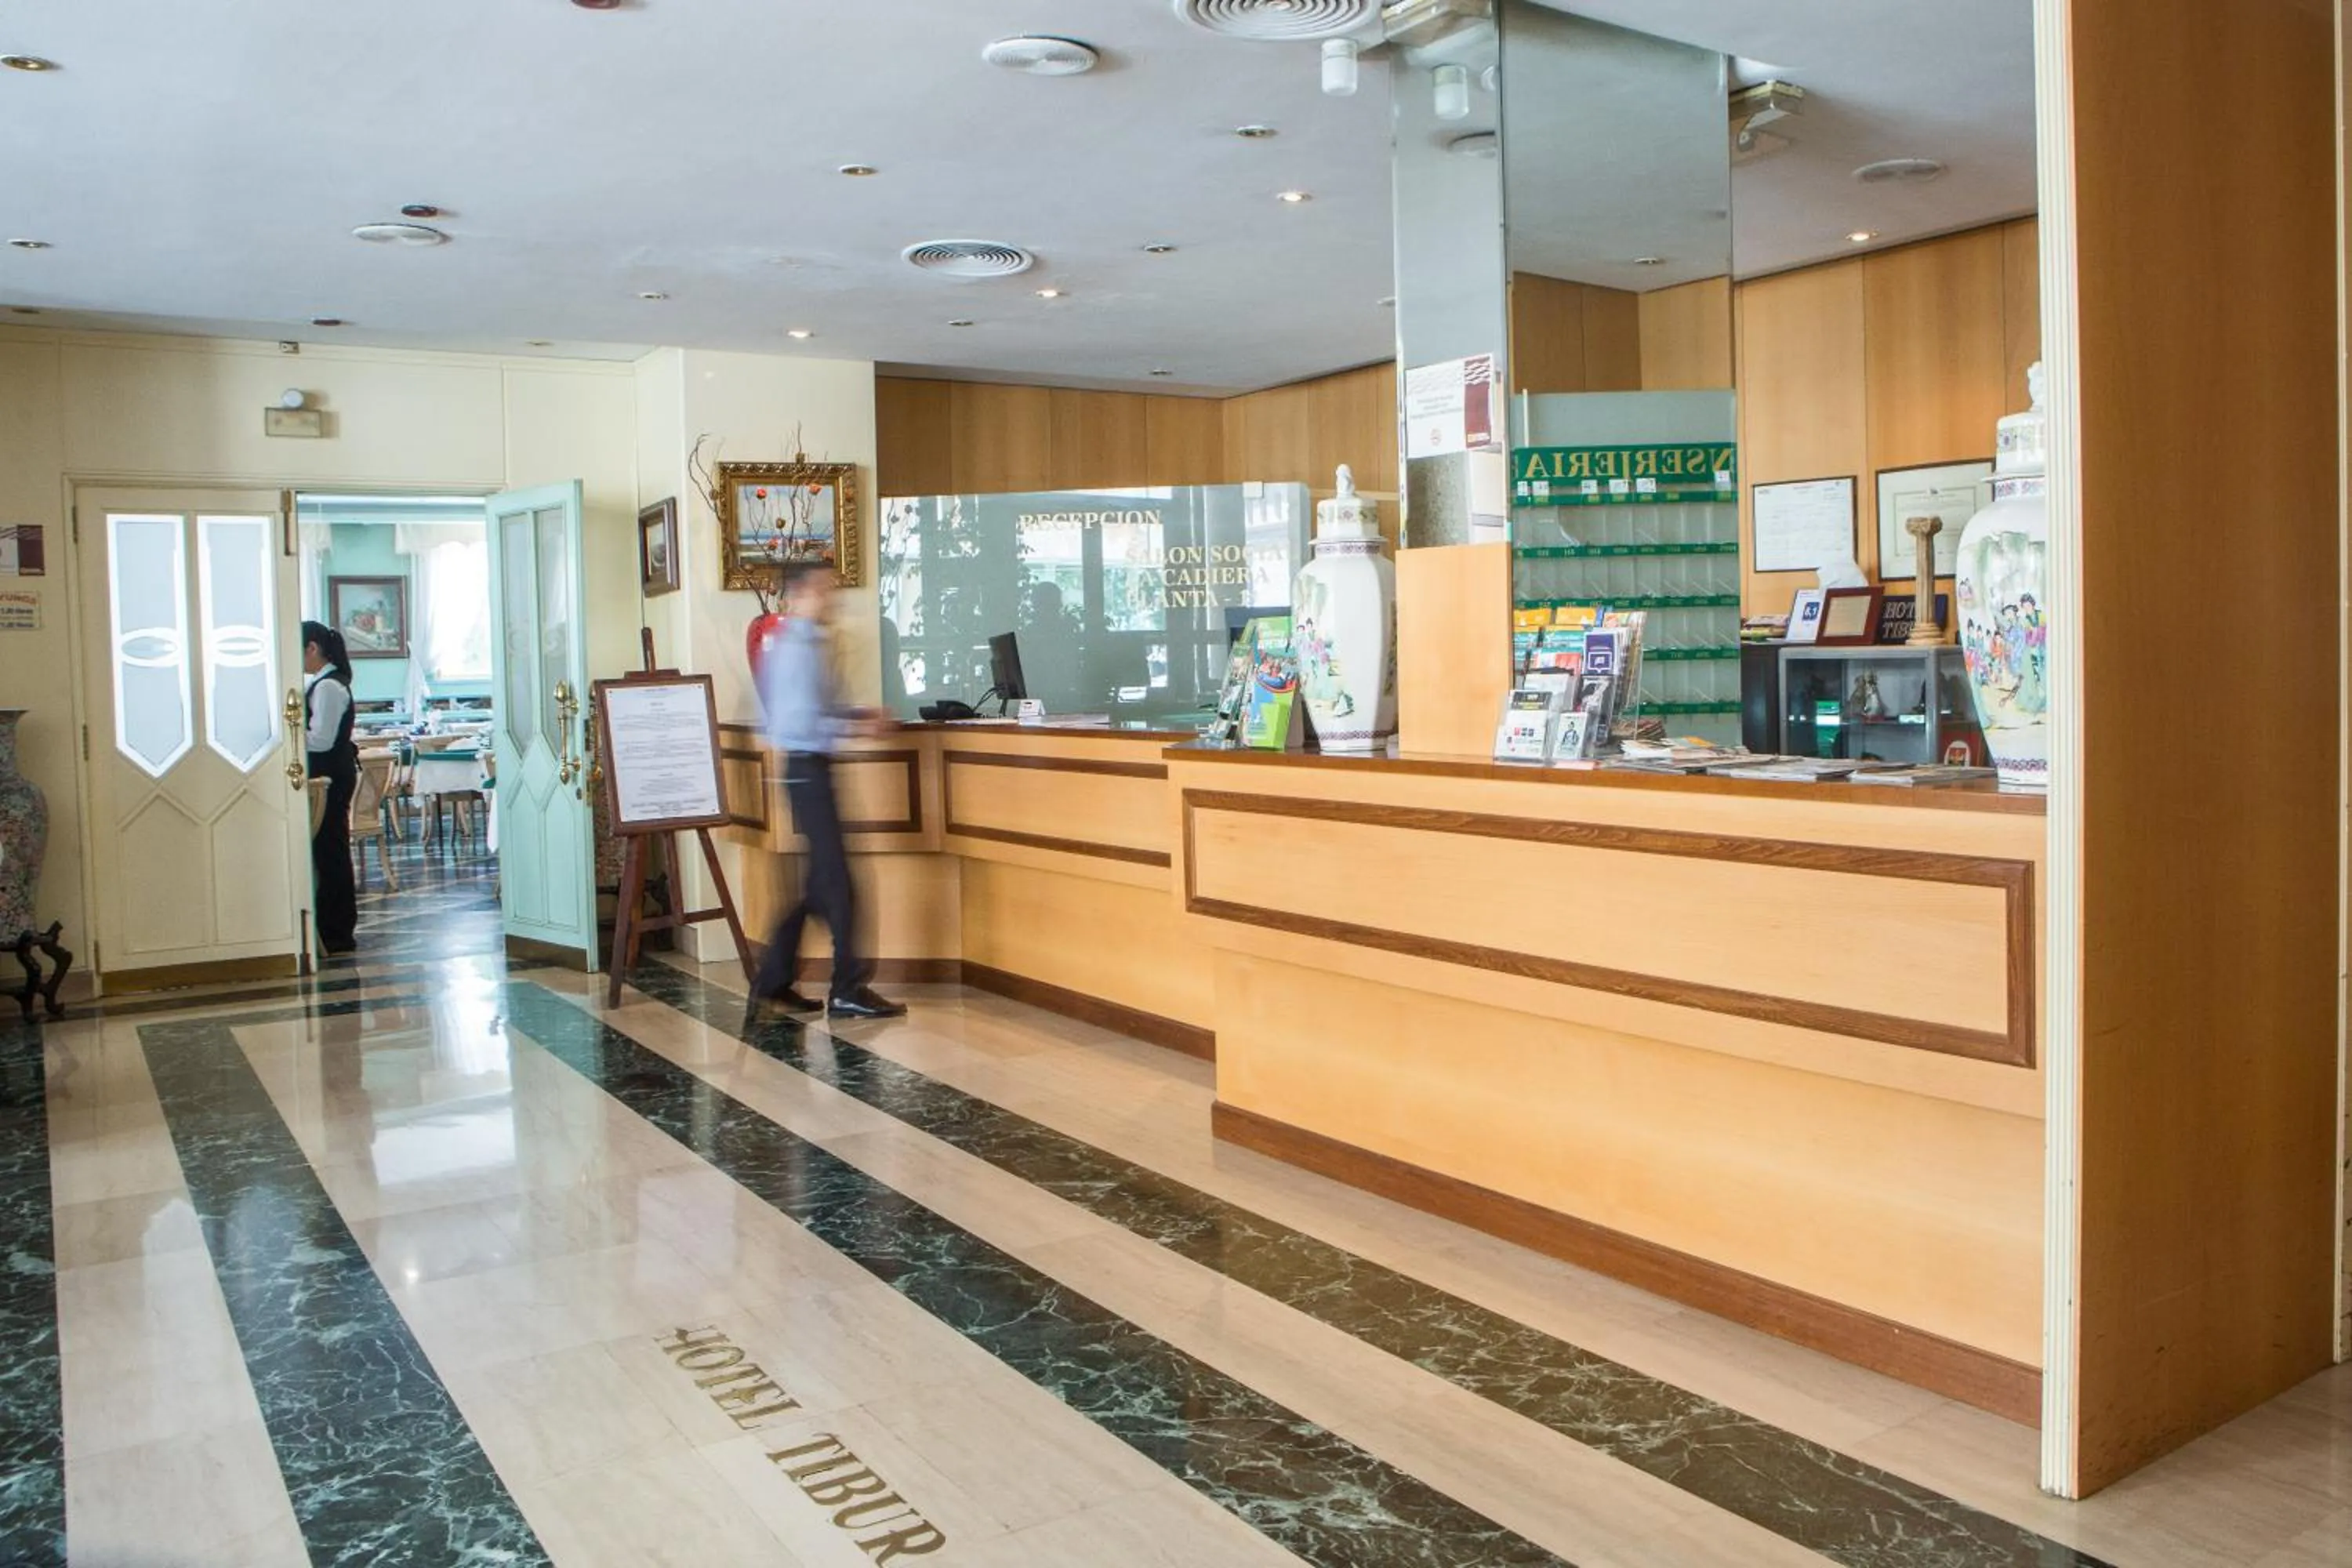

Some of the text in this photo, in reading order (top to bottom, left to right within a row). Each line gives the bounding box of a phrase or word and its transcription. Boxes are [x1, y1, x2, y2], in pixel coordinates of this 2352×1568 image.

[1018, 510, 1161, 531] RECEPCION
[1210, 545, 1287, 563] SOCIA
[1163, 567, 1270, 586] CADIERA
[1127, 589, 1218, 609] PLANTA
[1882, 601, 1915, 618] HOT
[1882, 621, 1913, 638] TIB
[652, 1325, 803, 1431] HOTEL
[765, 1432, 946, 1568] TIBUR
